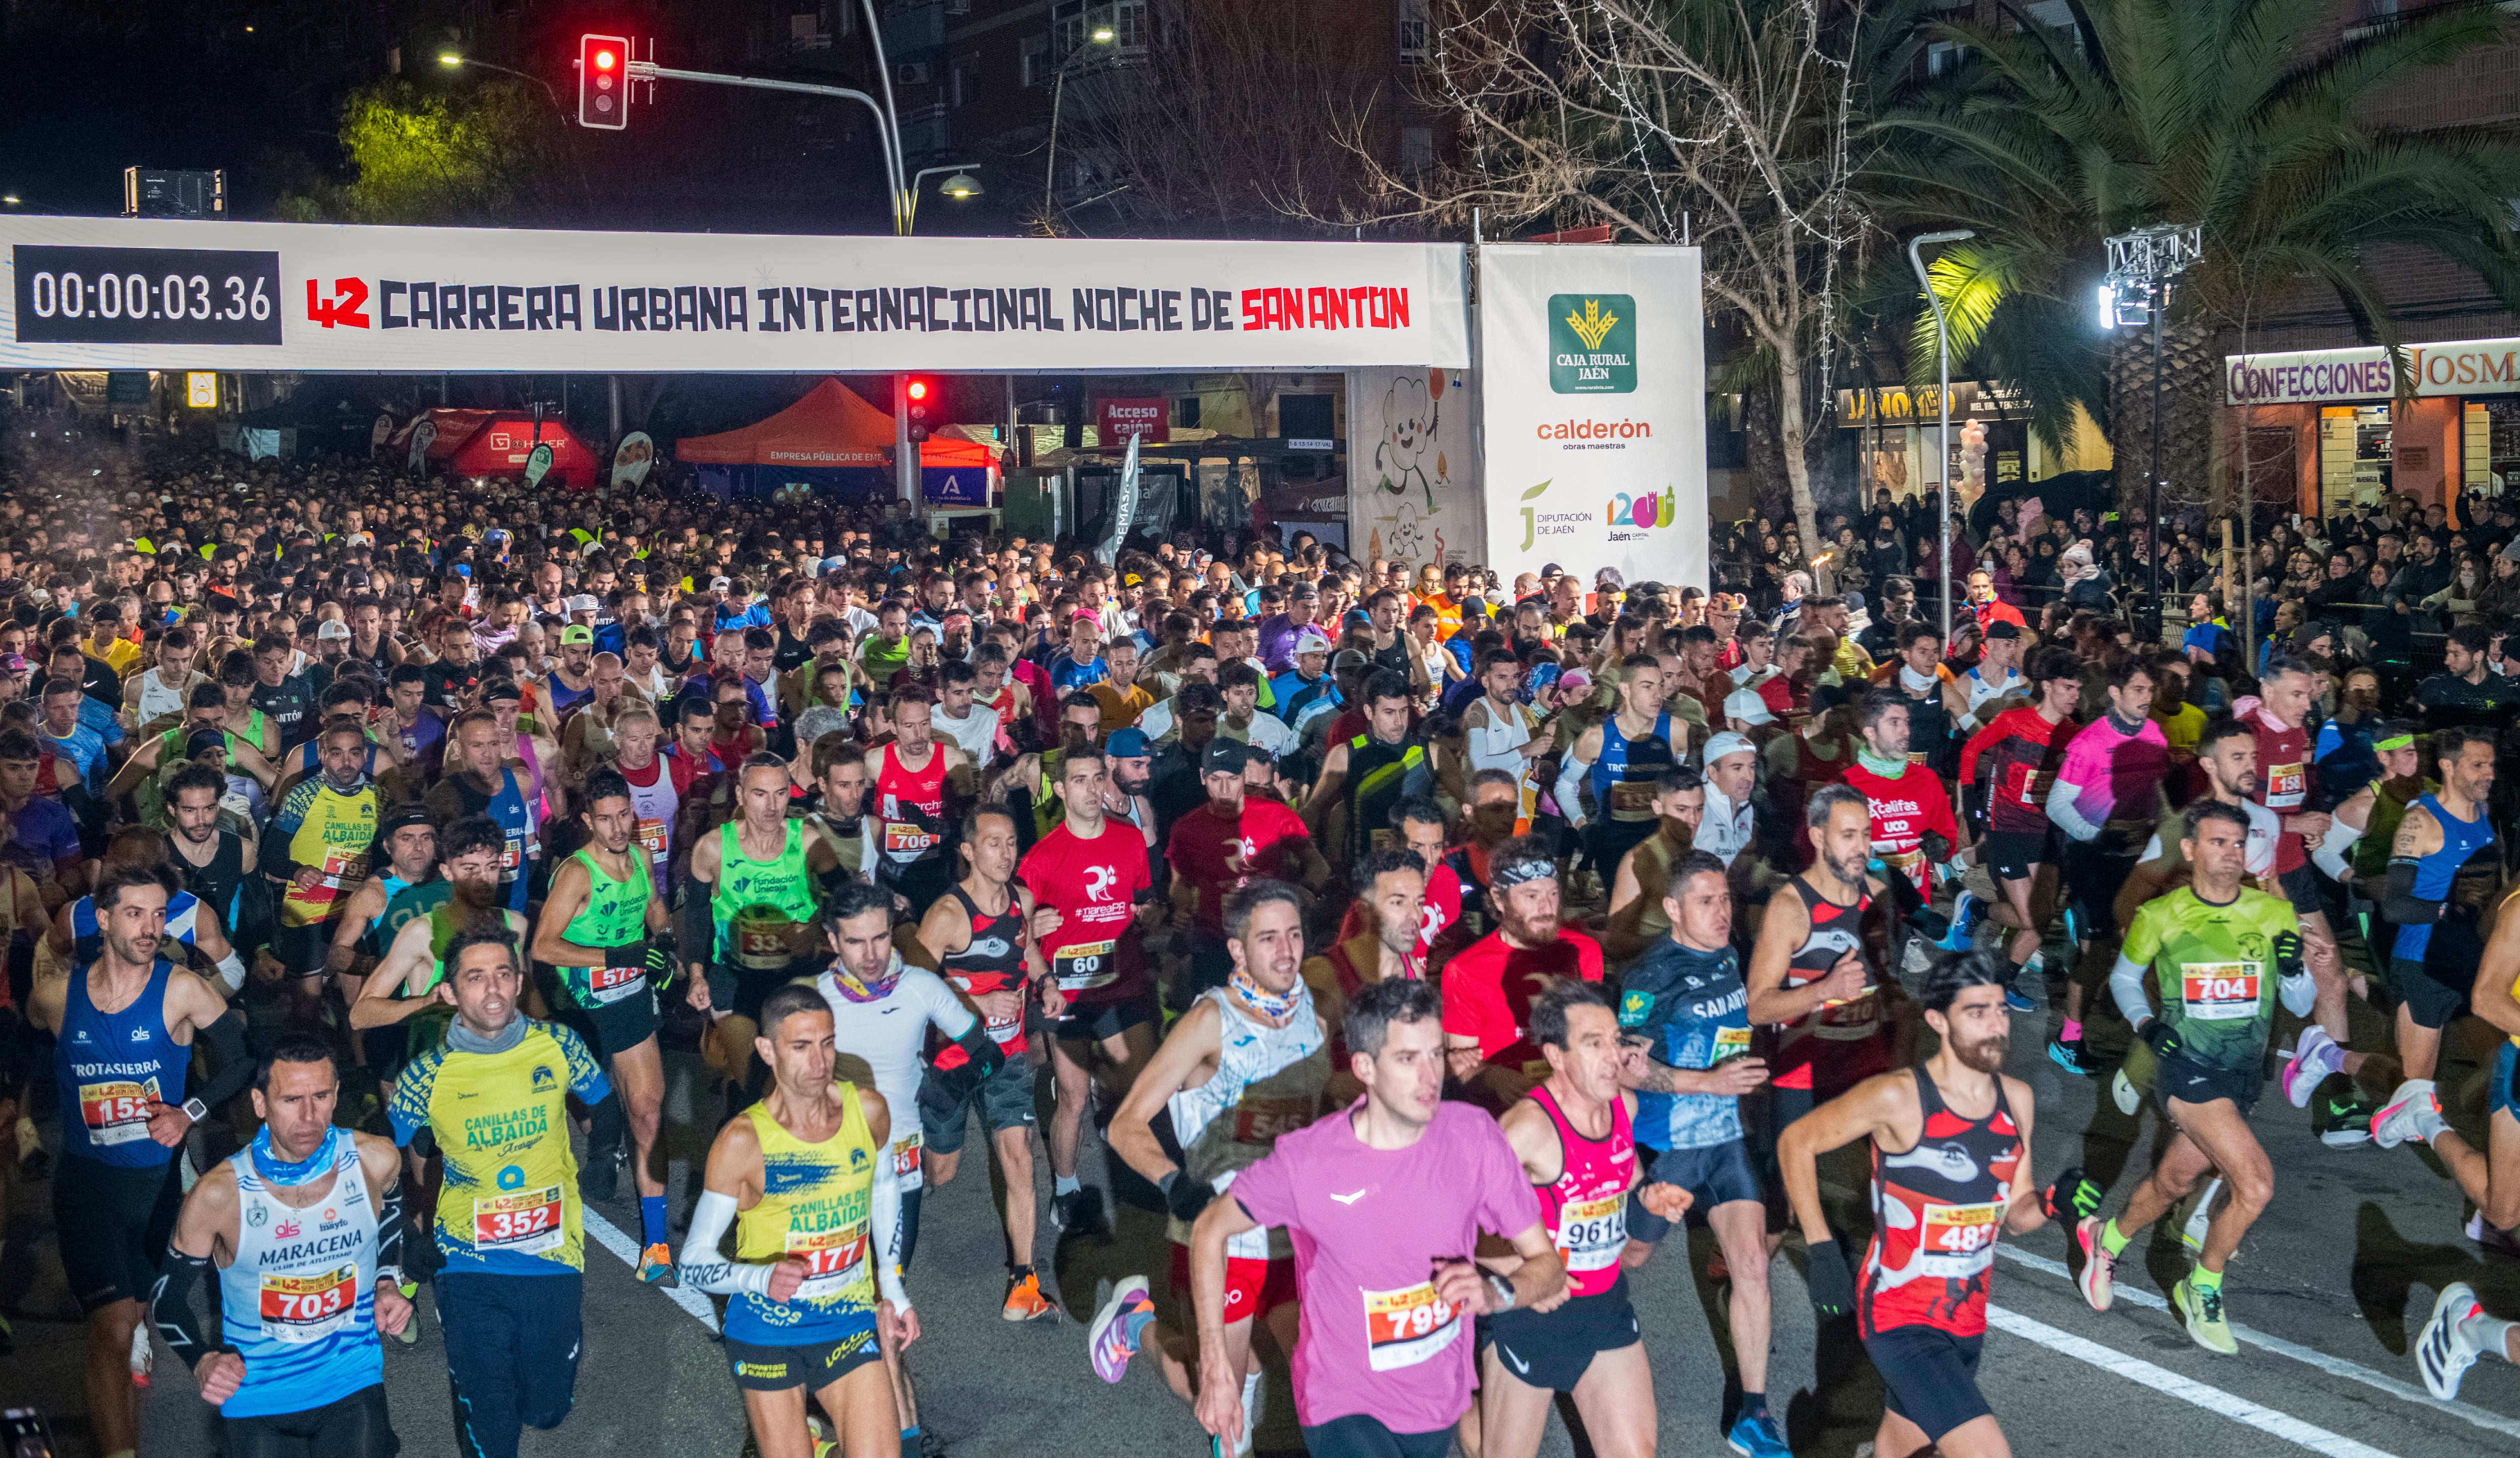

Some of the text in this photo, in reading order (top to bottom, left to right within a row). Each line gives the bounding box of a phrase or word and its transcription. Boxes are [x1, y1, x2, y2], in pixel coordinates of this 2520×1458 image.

[33, 272, 270, 322] 00:00:03.36
[306, 277, 370, 330] 42
[380, 279, 582, 331] CARRERA
[593, 286, 748, 332] URBANA
[758, 286, 1064, 333] INTERNACIONAL
[1073, 286, 1182, 332] NOCHE
[1190, 287, 1234, 332] DE
[1241, 287, 1304, 331] SAN
[1556, 354, 1630, 367] CAJA RURAL
[1578, 364, 1609, 381] JAÉN
[2231, 360, 2392, 401] CONFECCIONES
[1108, 404, 1158, 418] Acceso
[1113, 419, 1153, 436] cajón
[1537, 418, 1651, 440] calderón
[771, 451, 811, 461] EMPRESA
[813, 450, 850, 462] PÚBLICA
[1537, 512, 1592, 523] DIPUTACIÓN
[1537, 524, 1574, 535] DE JAÉN
[1608, 531, 1631, 542] Jaén
[322, 830, 372, 843] ALBAIDA
[324, 821, 361, 831] CANILLAS
[896, 835, 930, 849] 706
[753, 874, 799, 885] Fundación
[753, 883, 787, 894] Unicaja
[1073, 955, 1099, 974] 60
[2196, 978, 2247, 999] 704
[99, 1097, 152, 1122] 152
[465, 1105, 546, 1131] CANILLAS DE
[467, 1117, 548, 1147] ALBAIDA
[790, 1187, 867, 1216] CANILLAS DE
[493, 1206, 549, 1237] 352
[789, 1202, 867, 1233] ALBAIDA
[275, 1219, 301, 1240] als
[1938, 1223, 1993, 1251] 482
[259, 1228, 362, 1266] MARACENA
[808, 1236, 826, 1247] 42
[273, 1263, 294, 1272] CLUB
[309, 1250, 352, 1265] ATLETISMO
[807, 1239, 859, 1275] 177
[282, 1279, 301, 1291] 42
[278, 1287, 341, 1319] 703
[1387, 1297, 1452, 1340] 799
